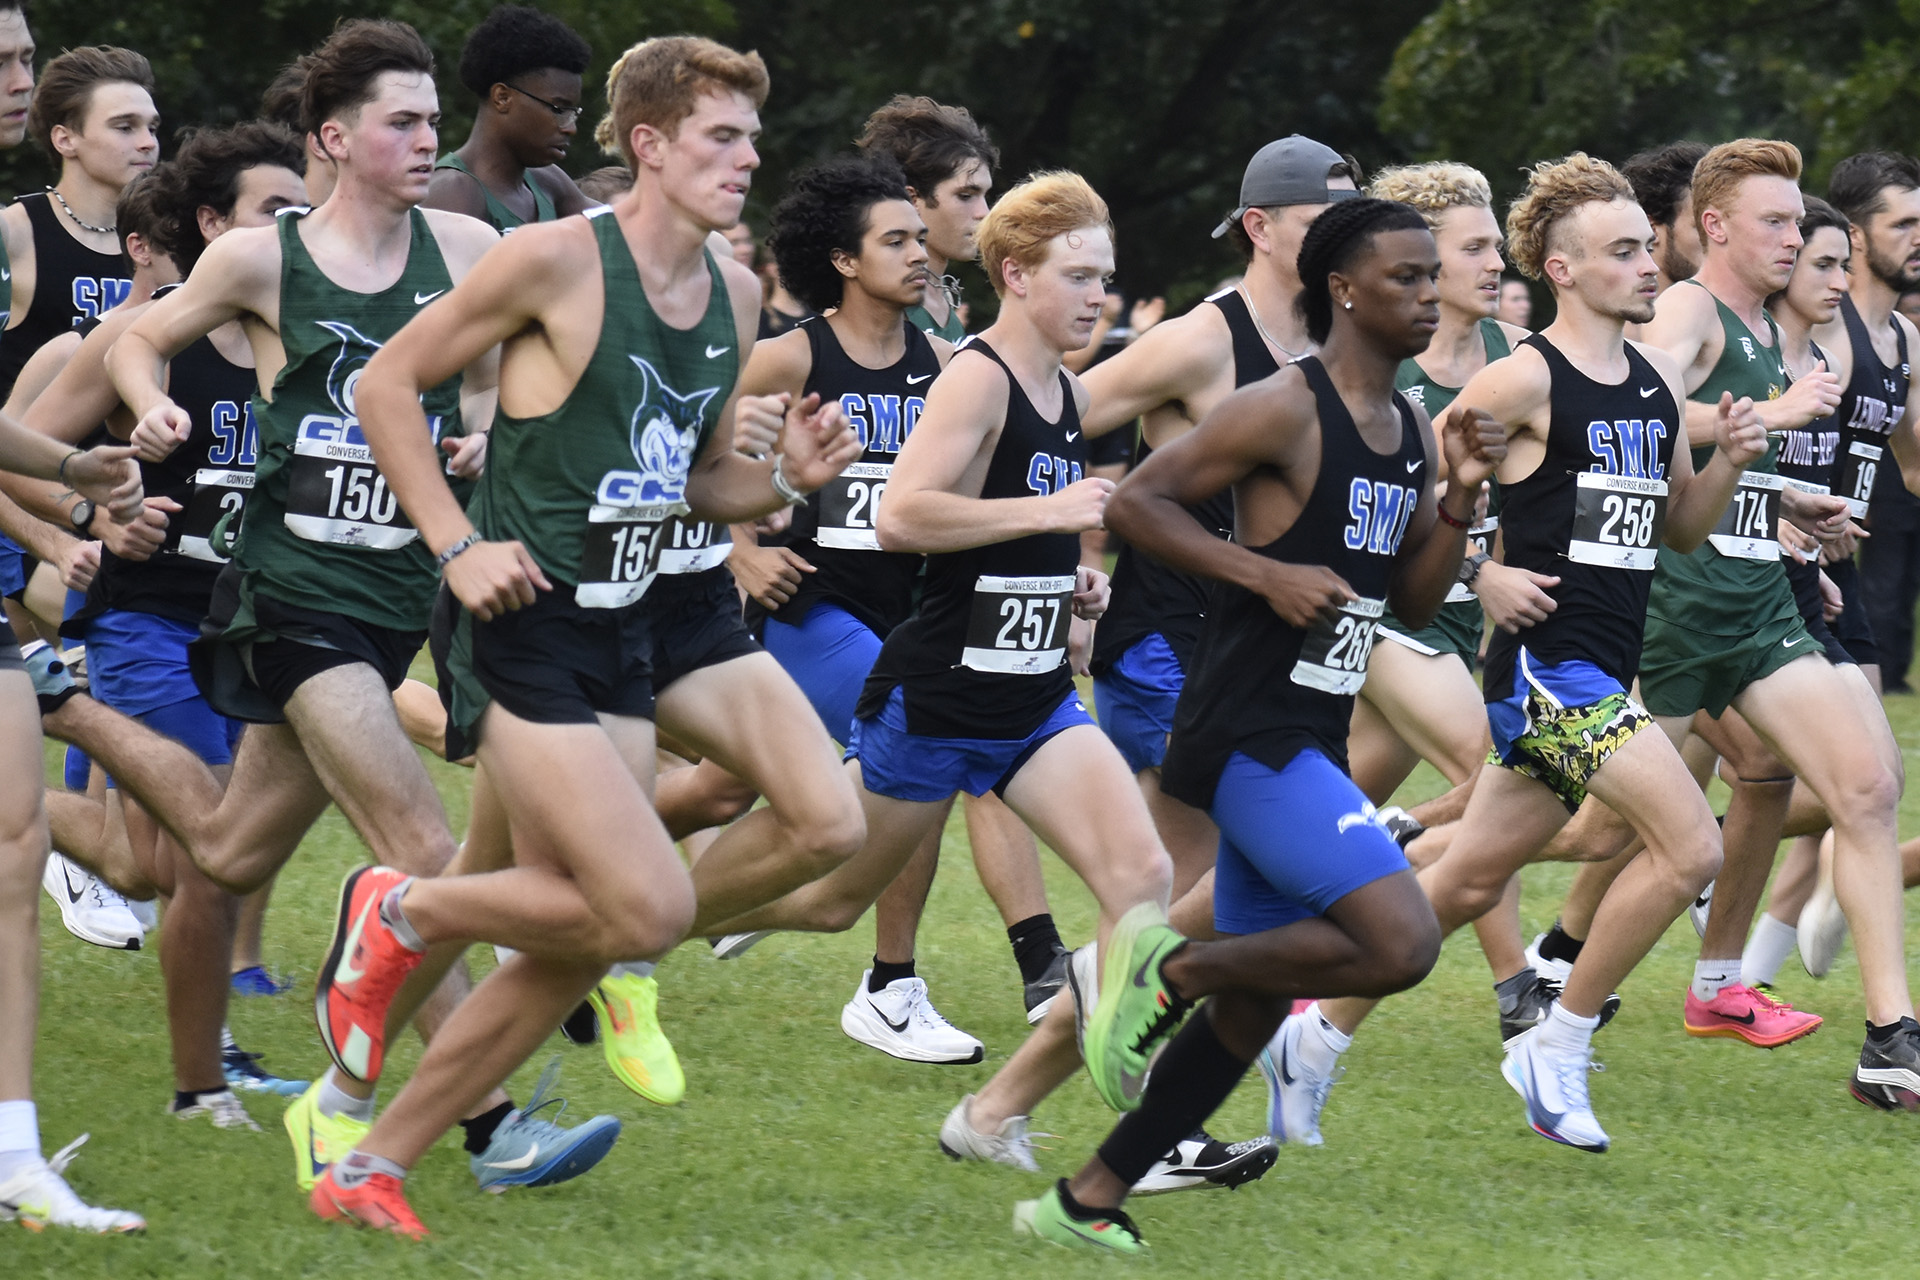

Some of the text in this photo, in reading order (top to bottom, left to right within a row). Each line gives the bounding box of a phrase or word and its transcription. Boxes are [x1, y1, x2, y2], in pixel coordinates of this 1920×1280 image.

[326, 445, 366, 459] CONVERSE
[1587, 419, 1667, 480] SMC
[226, 473, 256, 486] CONVER
[325, 465, 397, 524] 150
[1606, 477, 1638, 491] CONVERSE
[1599, 495, 1656, 547] 258
[1734, 490, 1769, 538] 174
[1004, 580, 1062, 591] CONVERSE KICK-OFF
[995, 598, 1060, 650] 257
